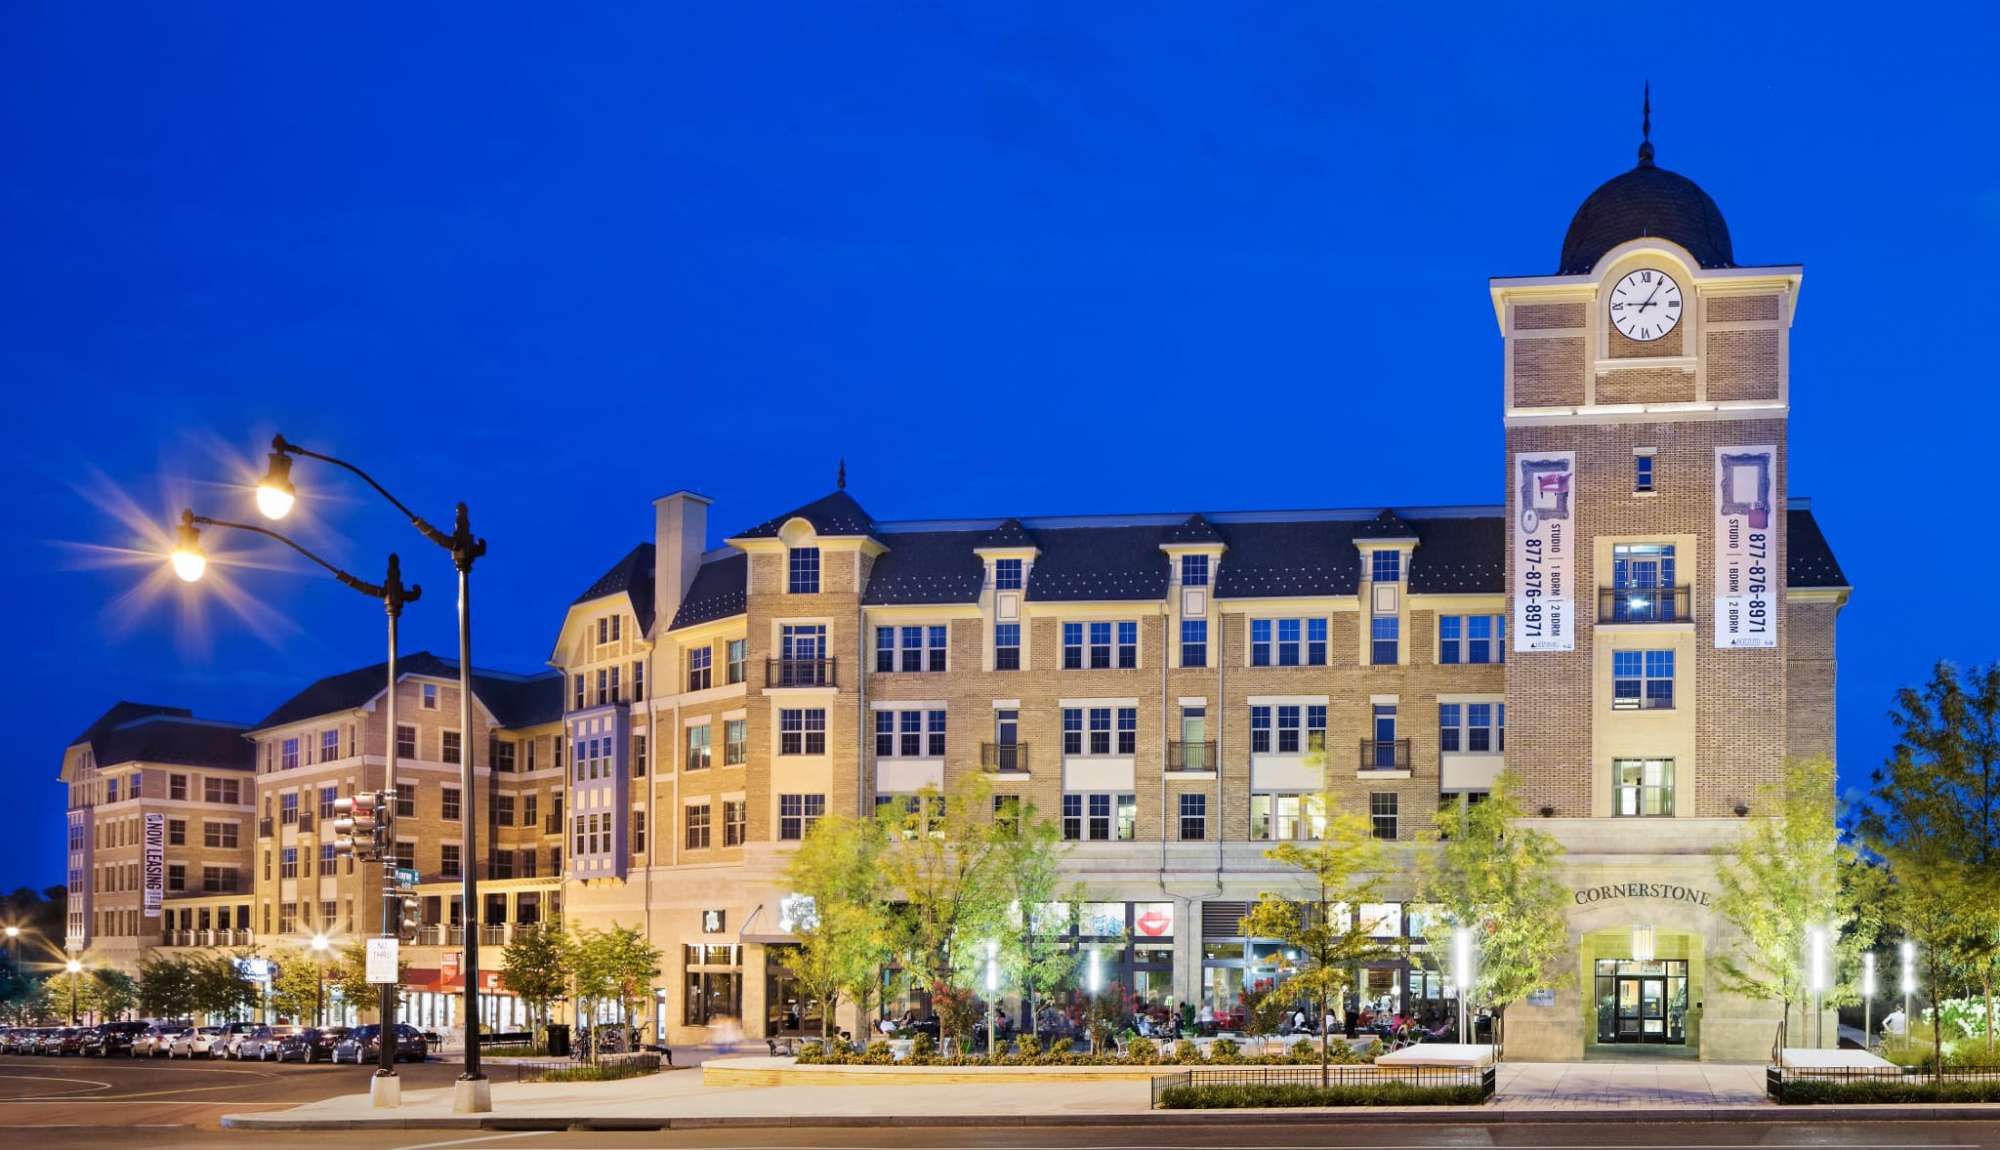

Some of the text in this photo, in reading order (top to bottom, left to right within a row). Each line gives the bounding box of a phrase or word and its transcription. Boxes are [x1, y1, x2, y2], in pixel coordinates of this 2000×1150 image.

[1551, 523, 1561, 553] STUDIO
[1728, 519, 1739, 549] STUDIO
[1525, 539, 1542, 637] 877-876-8971
[1551, 572, 1561, 596] BDRM
[1728, 568, 1739, 593] BDRM
[1748, 533, 1766, 633] 877-876-8971
[1551, 613, 1561, 637] BDRM
[1728, 609, 1739, 634] BDRM
[146, 822, 163, 846] NOW
[146, 848, 163, 890] LEASING
[1575, 883, 1712, 907] CORNERSTONE
